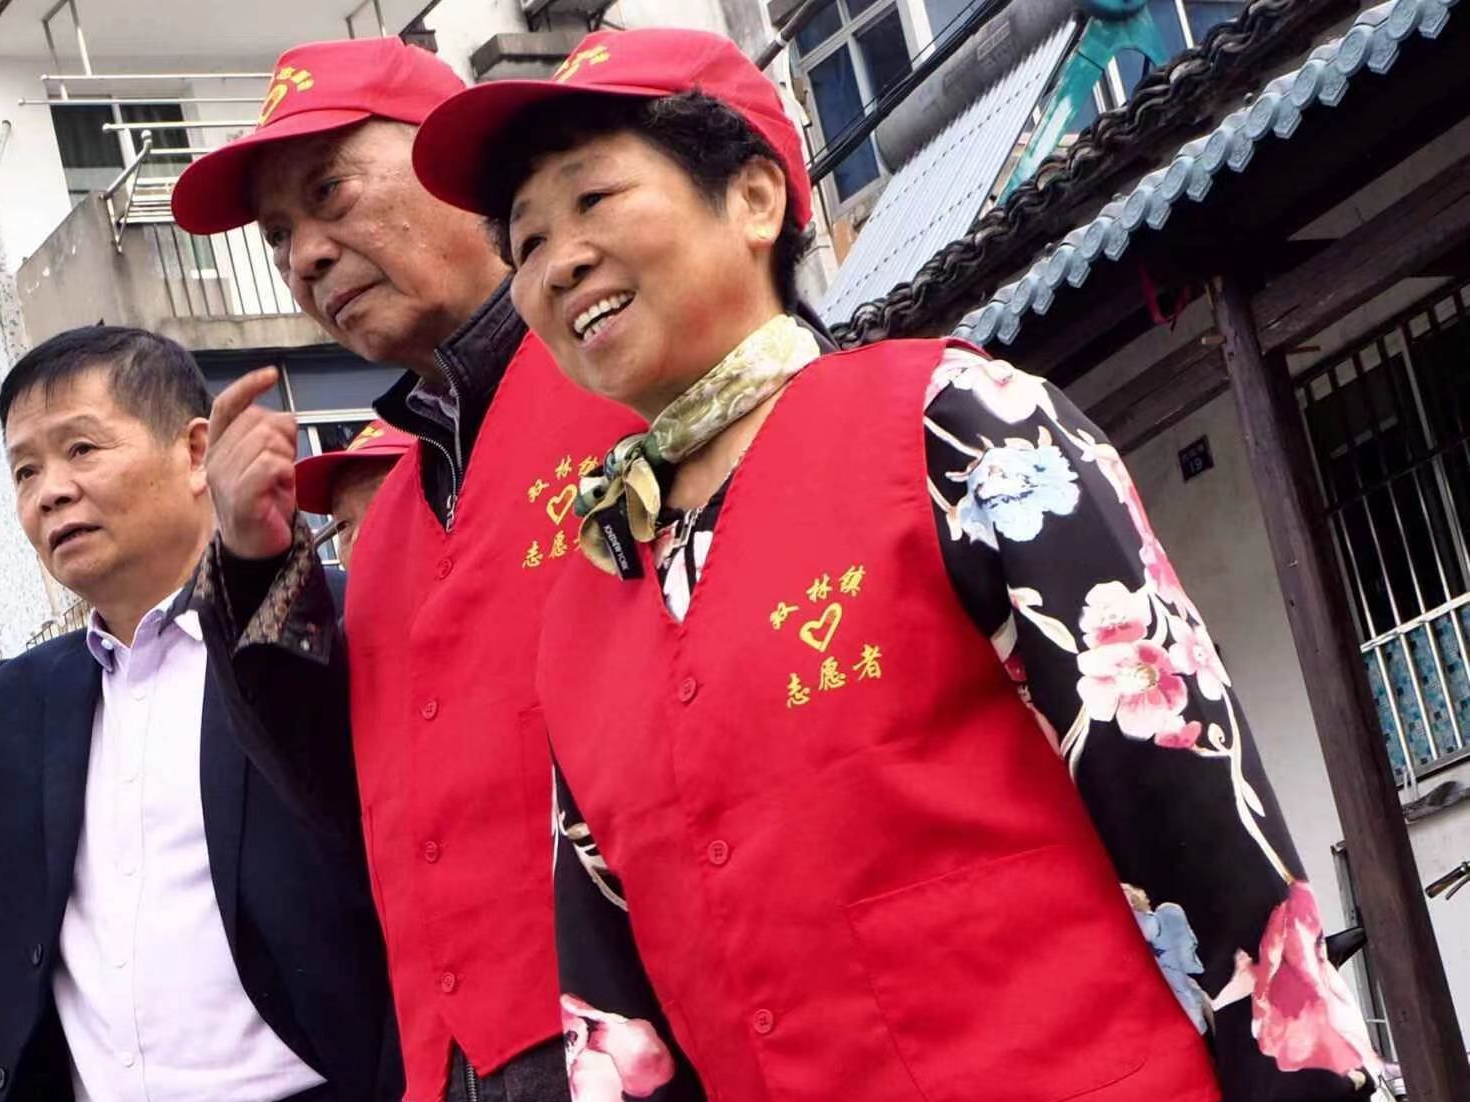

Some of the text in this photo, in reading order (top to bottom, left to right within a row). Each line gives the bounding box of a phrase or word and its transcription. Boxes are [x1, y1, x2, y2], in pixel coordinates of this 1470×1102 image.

[522, 530, 581, 568] 志愿
[786, 643, 882, 709] 志愿者
